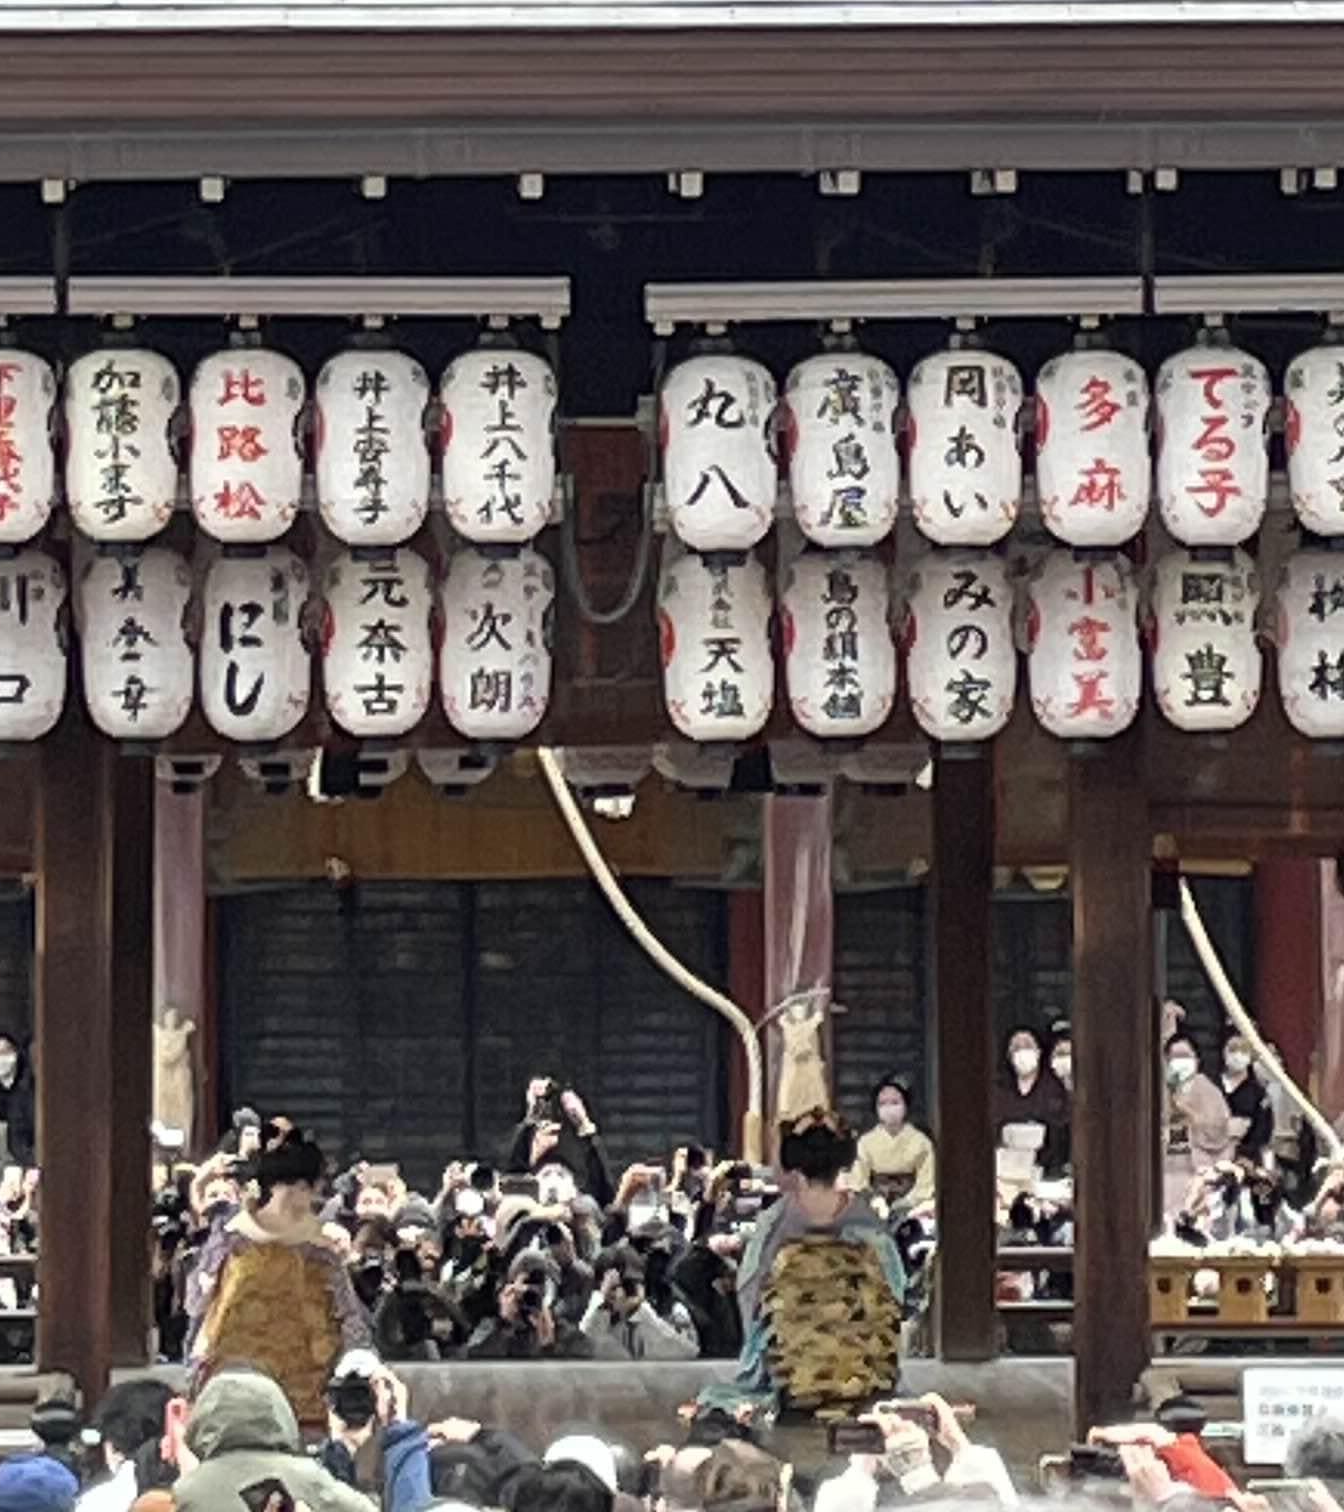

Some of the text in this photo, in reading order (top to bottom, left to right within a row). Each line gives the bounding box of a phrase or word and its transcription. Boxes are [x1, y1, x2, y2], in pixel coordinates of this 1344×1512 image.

[214, 368, 269, 521] 比路松
[476, 362, 527, 526] 井上八千代
[685, 378, 750, 508] 丸八
[943, 365, 988, 518] 岡あい
[1068, 375, 1127, 511] 多麻
[1186, 368, 1241, 518] てる子
[220, 602, 265, 716] にし
[354, 561, 409, 716] 元奈古
[944, 569, 996, 723] みの家
